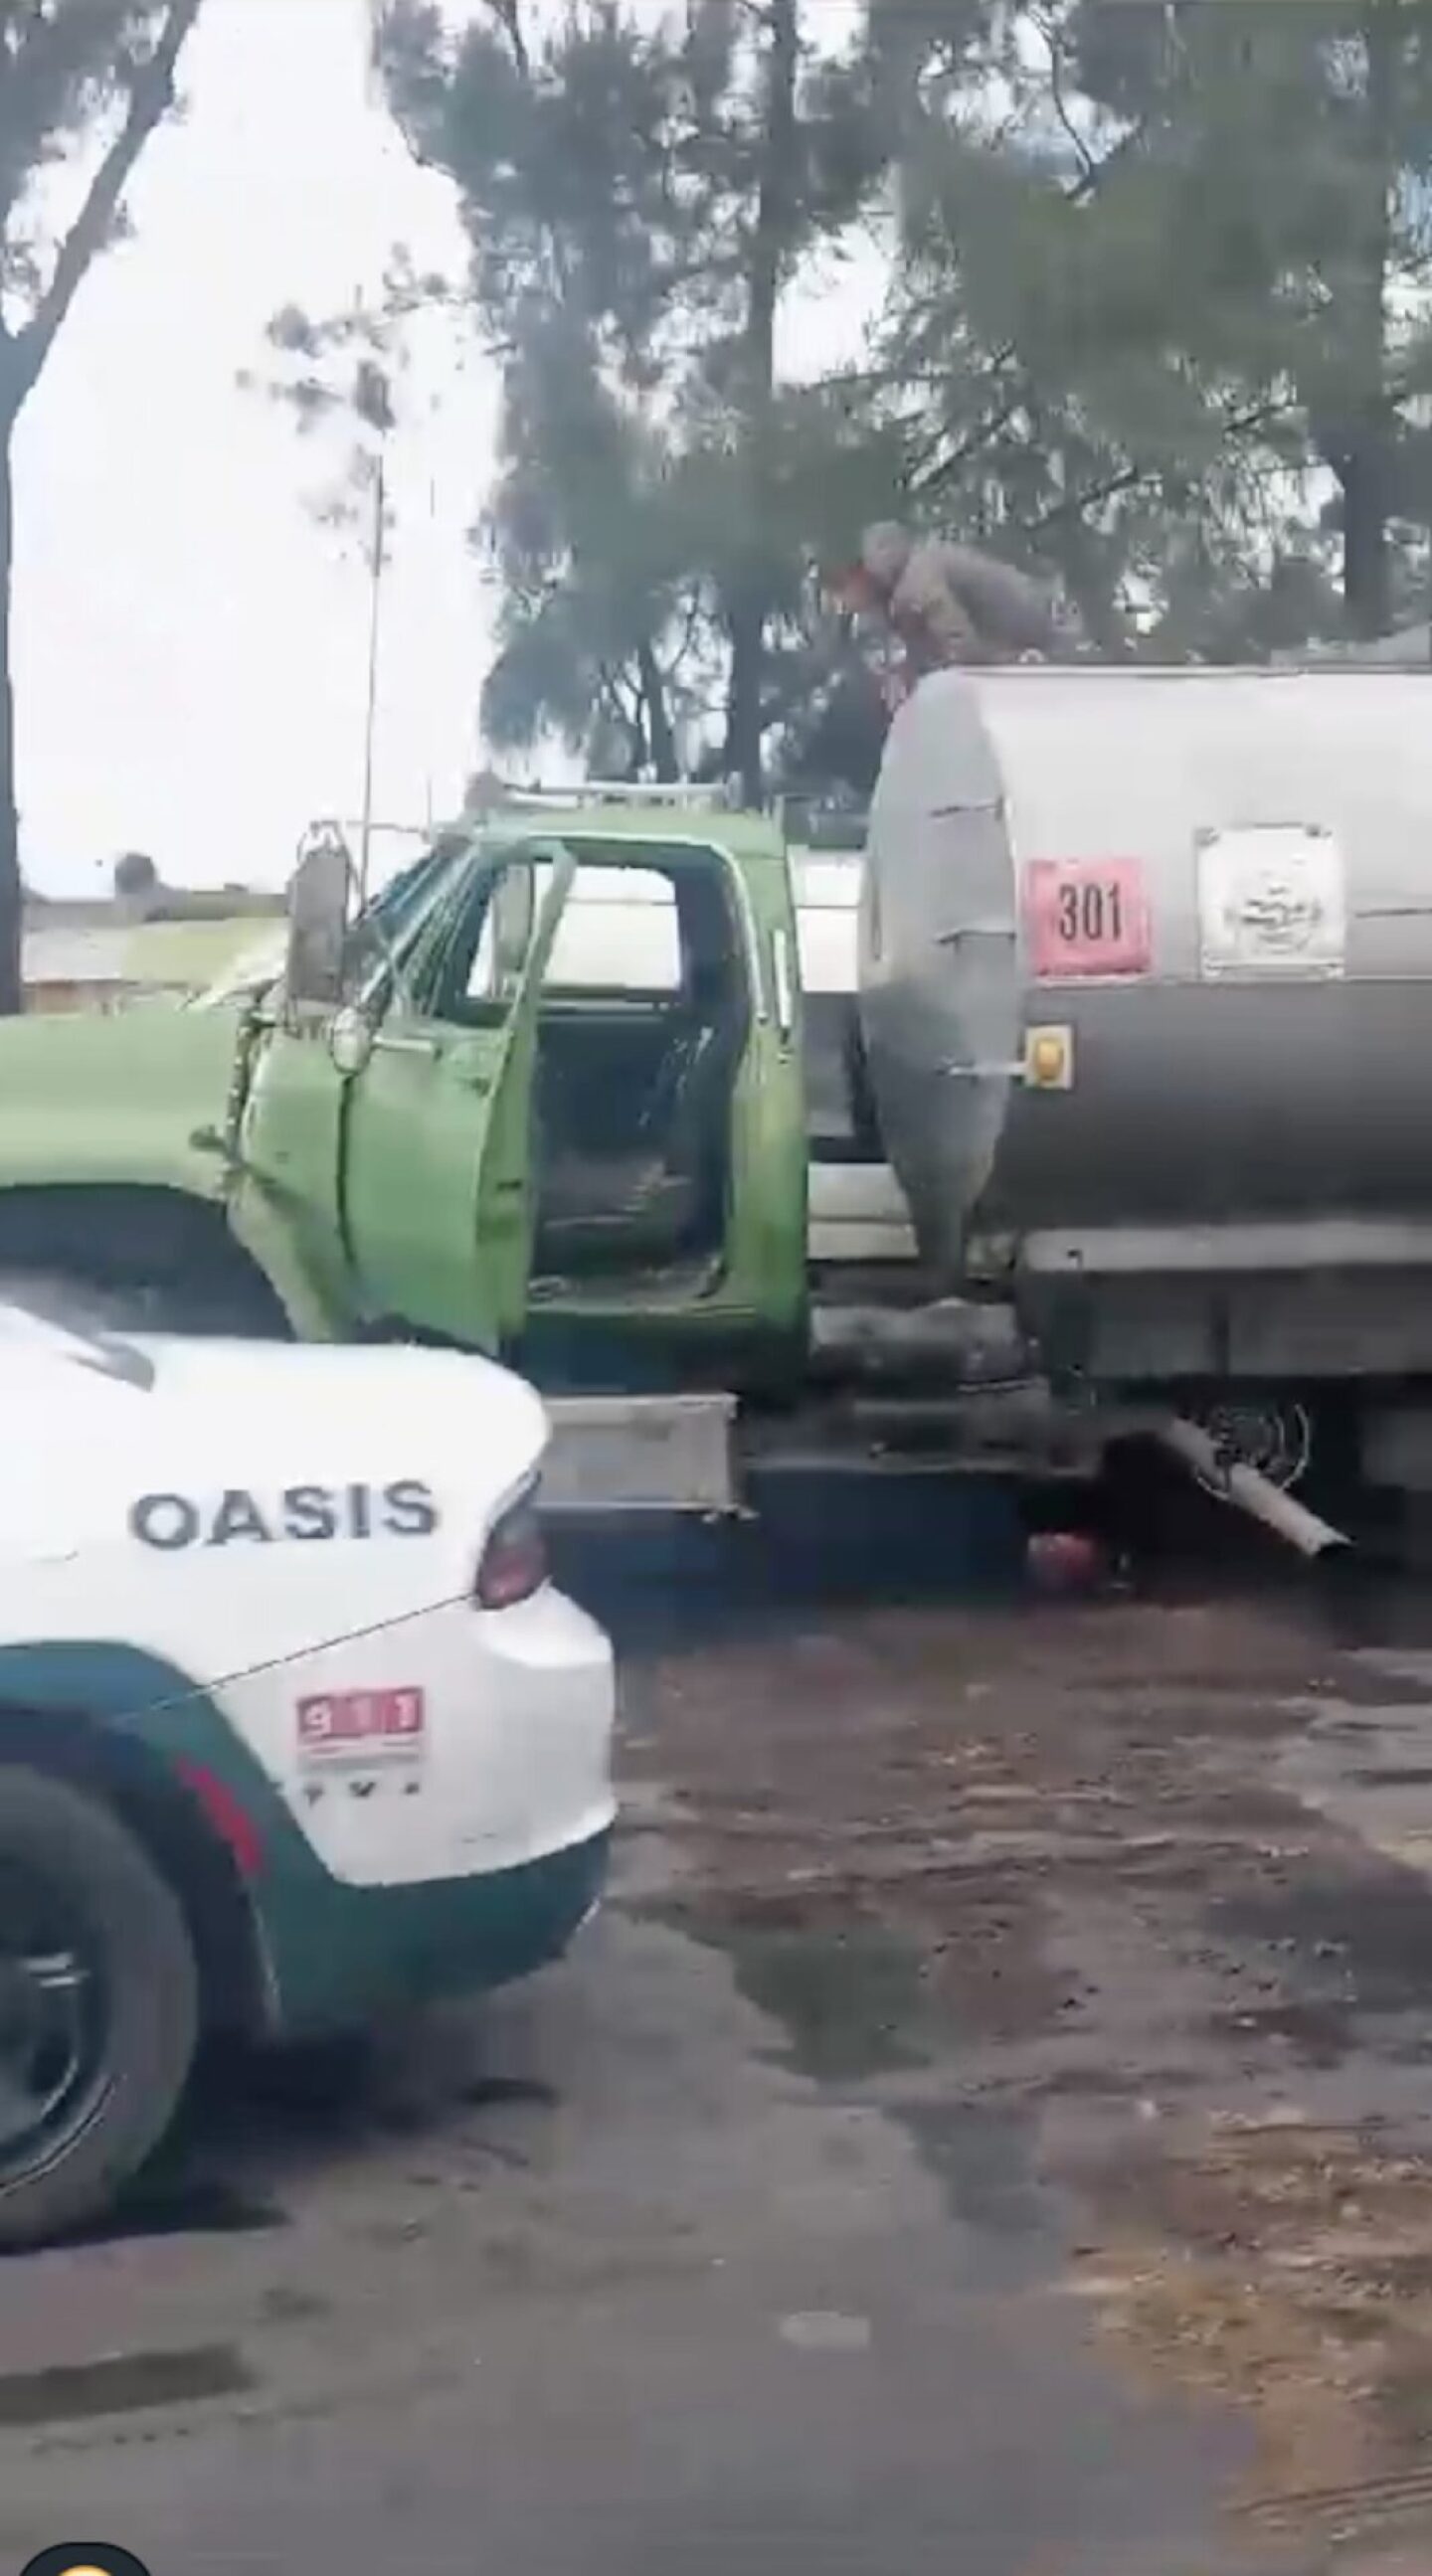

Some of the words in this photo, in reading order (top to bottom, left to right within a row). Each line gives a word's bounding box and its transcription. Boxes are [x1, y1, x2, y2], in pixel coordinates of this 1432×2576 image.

[1058, 881, 1123, 942] 301
[129, 1479, 439, 1551] OASIS
[302, 1691, 418, 1736] 911
